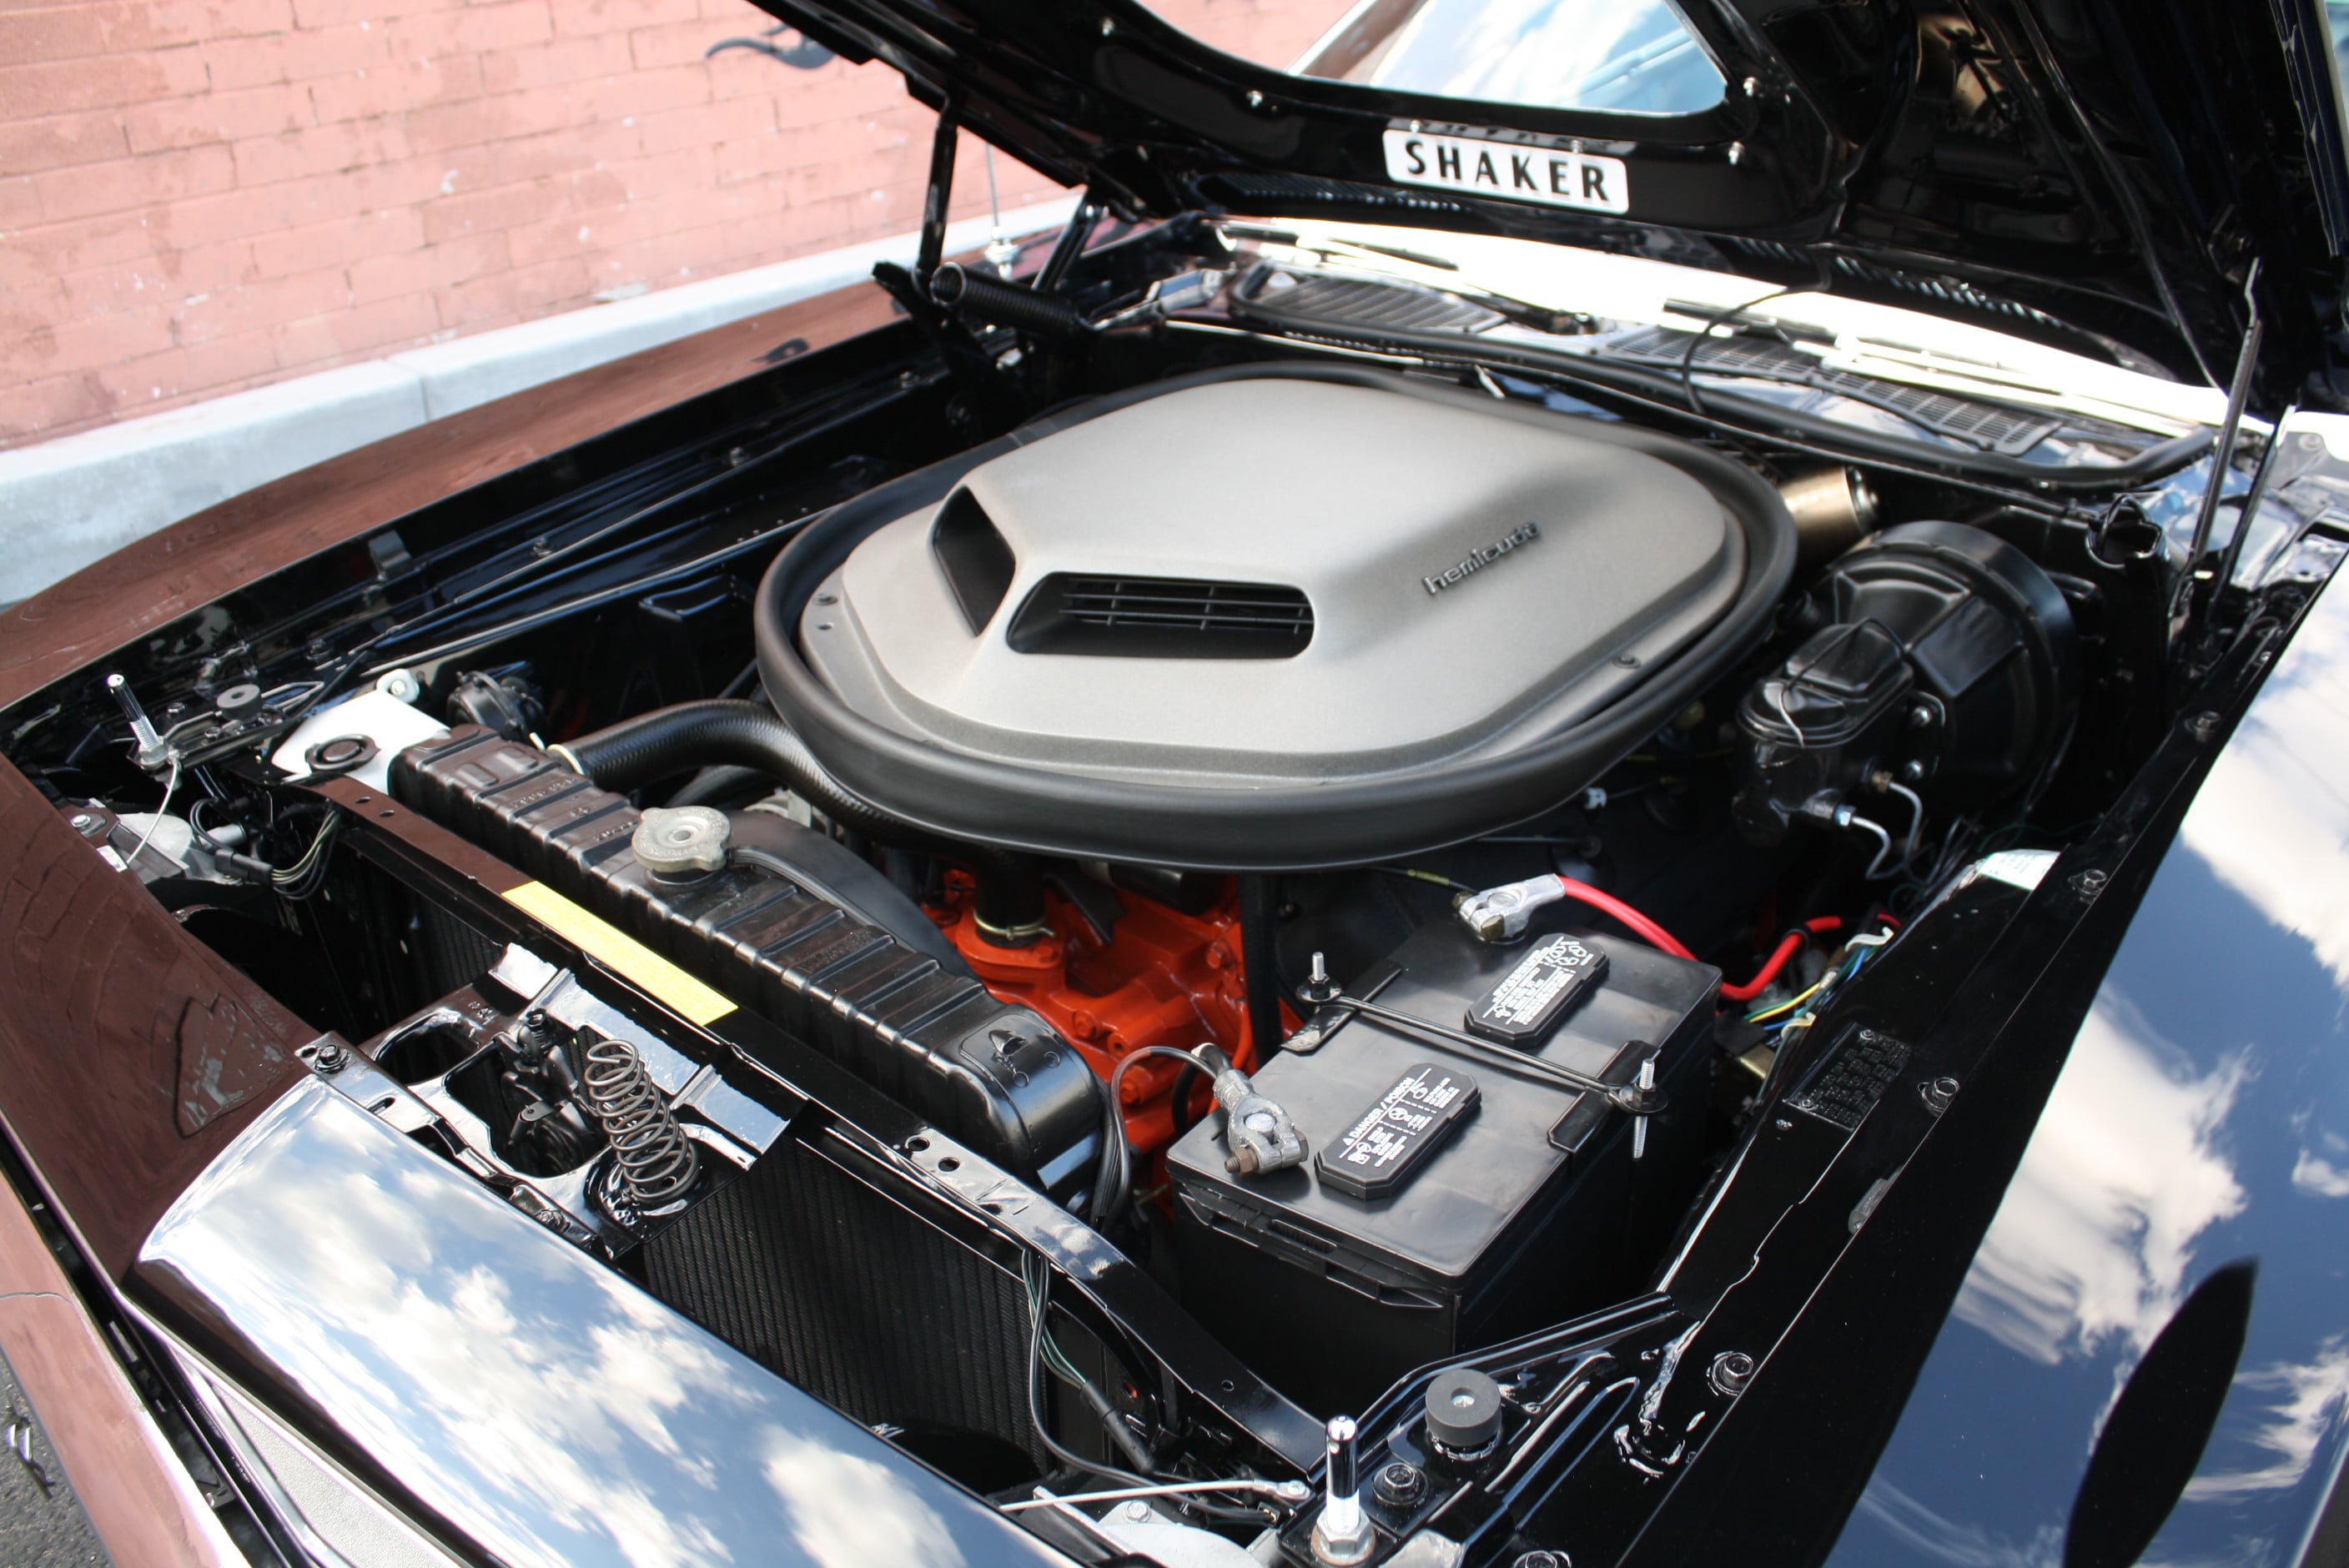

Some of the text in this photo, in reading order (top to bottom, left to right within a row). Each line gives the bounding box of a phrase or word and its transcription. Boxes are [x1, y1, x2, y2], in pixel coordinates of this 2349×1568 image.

[1405, 138, 1609, 202] SHAKER
[1349, 1108, 1384, 1138] DANGER
[1384, 1077, 1415, 1103] POISON
